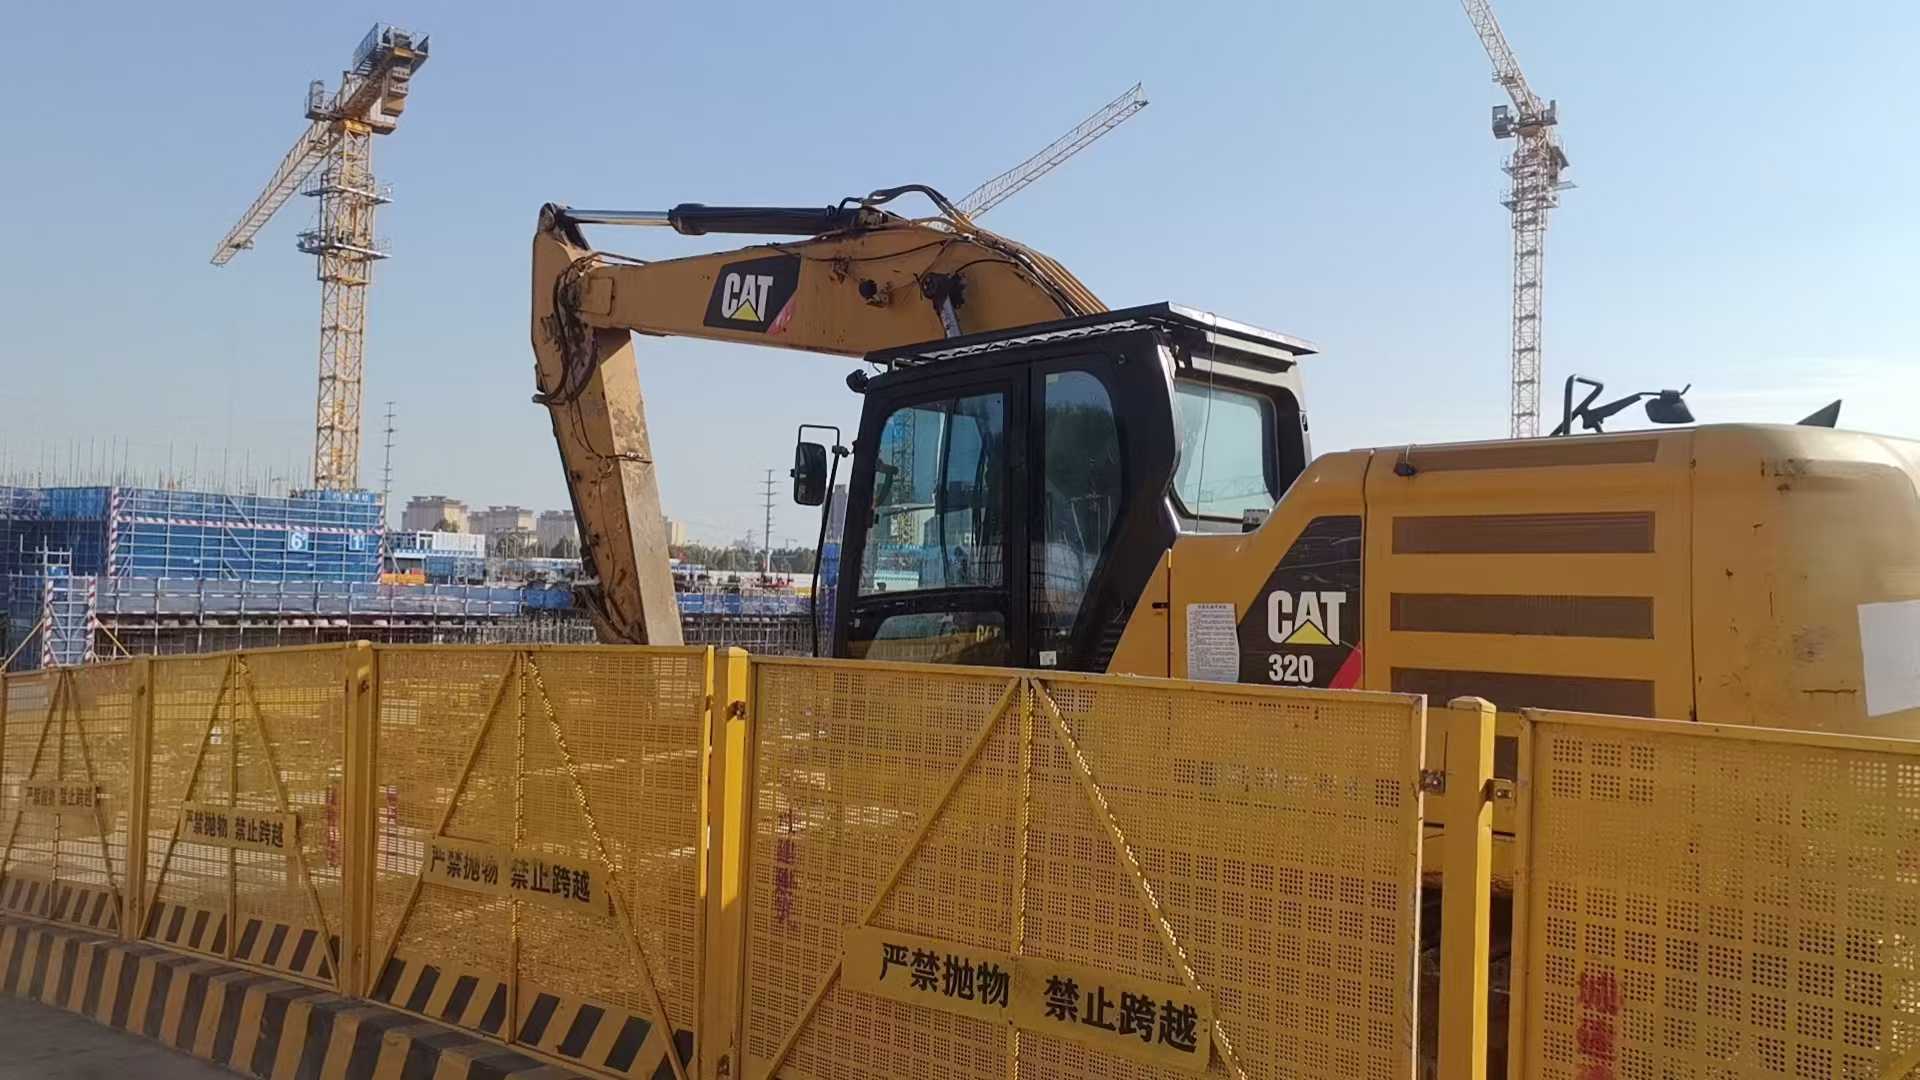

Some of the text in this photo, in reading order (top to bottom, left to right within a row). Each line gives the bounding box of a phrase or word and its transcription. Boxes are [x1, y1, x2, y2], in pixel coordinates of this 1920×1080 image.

[721, 272, 774, 322] CAT
[1267, 590, 1347, 648] CAT
[1268, 653, 1314, 683] 320
[235, 815, 284, 848] 禁止跨越
[430, 845, 591, 903] 严禁抛物 禁止跨越
[880, 942, 1198, 1053] 严禁抛物 禁止跨越
